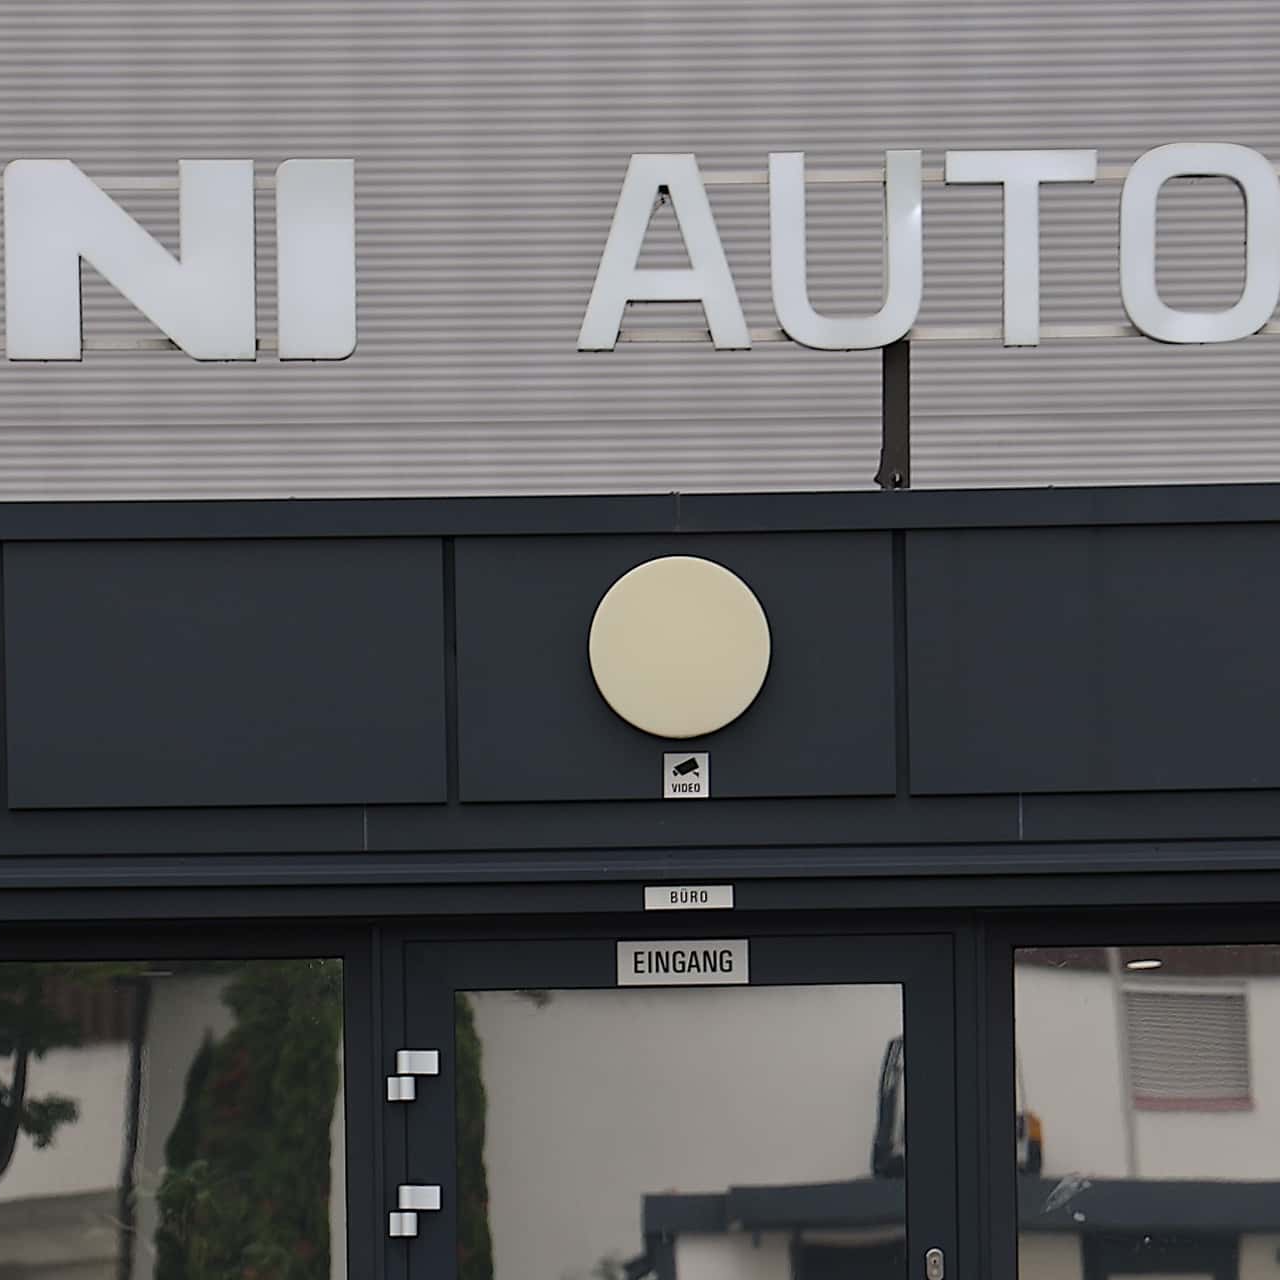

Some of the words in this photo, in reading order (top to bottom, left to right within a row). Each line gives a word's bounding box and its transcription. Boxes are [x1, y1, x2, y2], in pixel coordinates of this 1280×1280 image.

[671, 783, 701, 793] VIDEO
[670, 887, 708, 904] BÜRO
[633, 950, 733, 974] EINGANG
